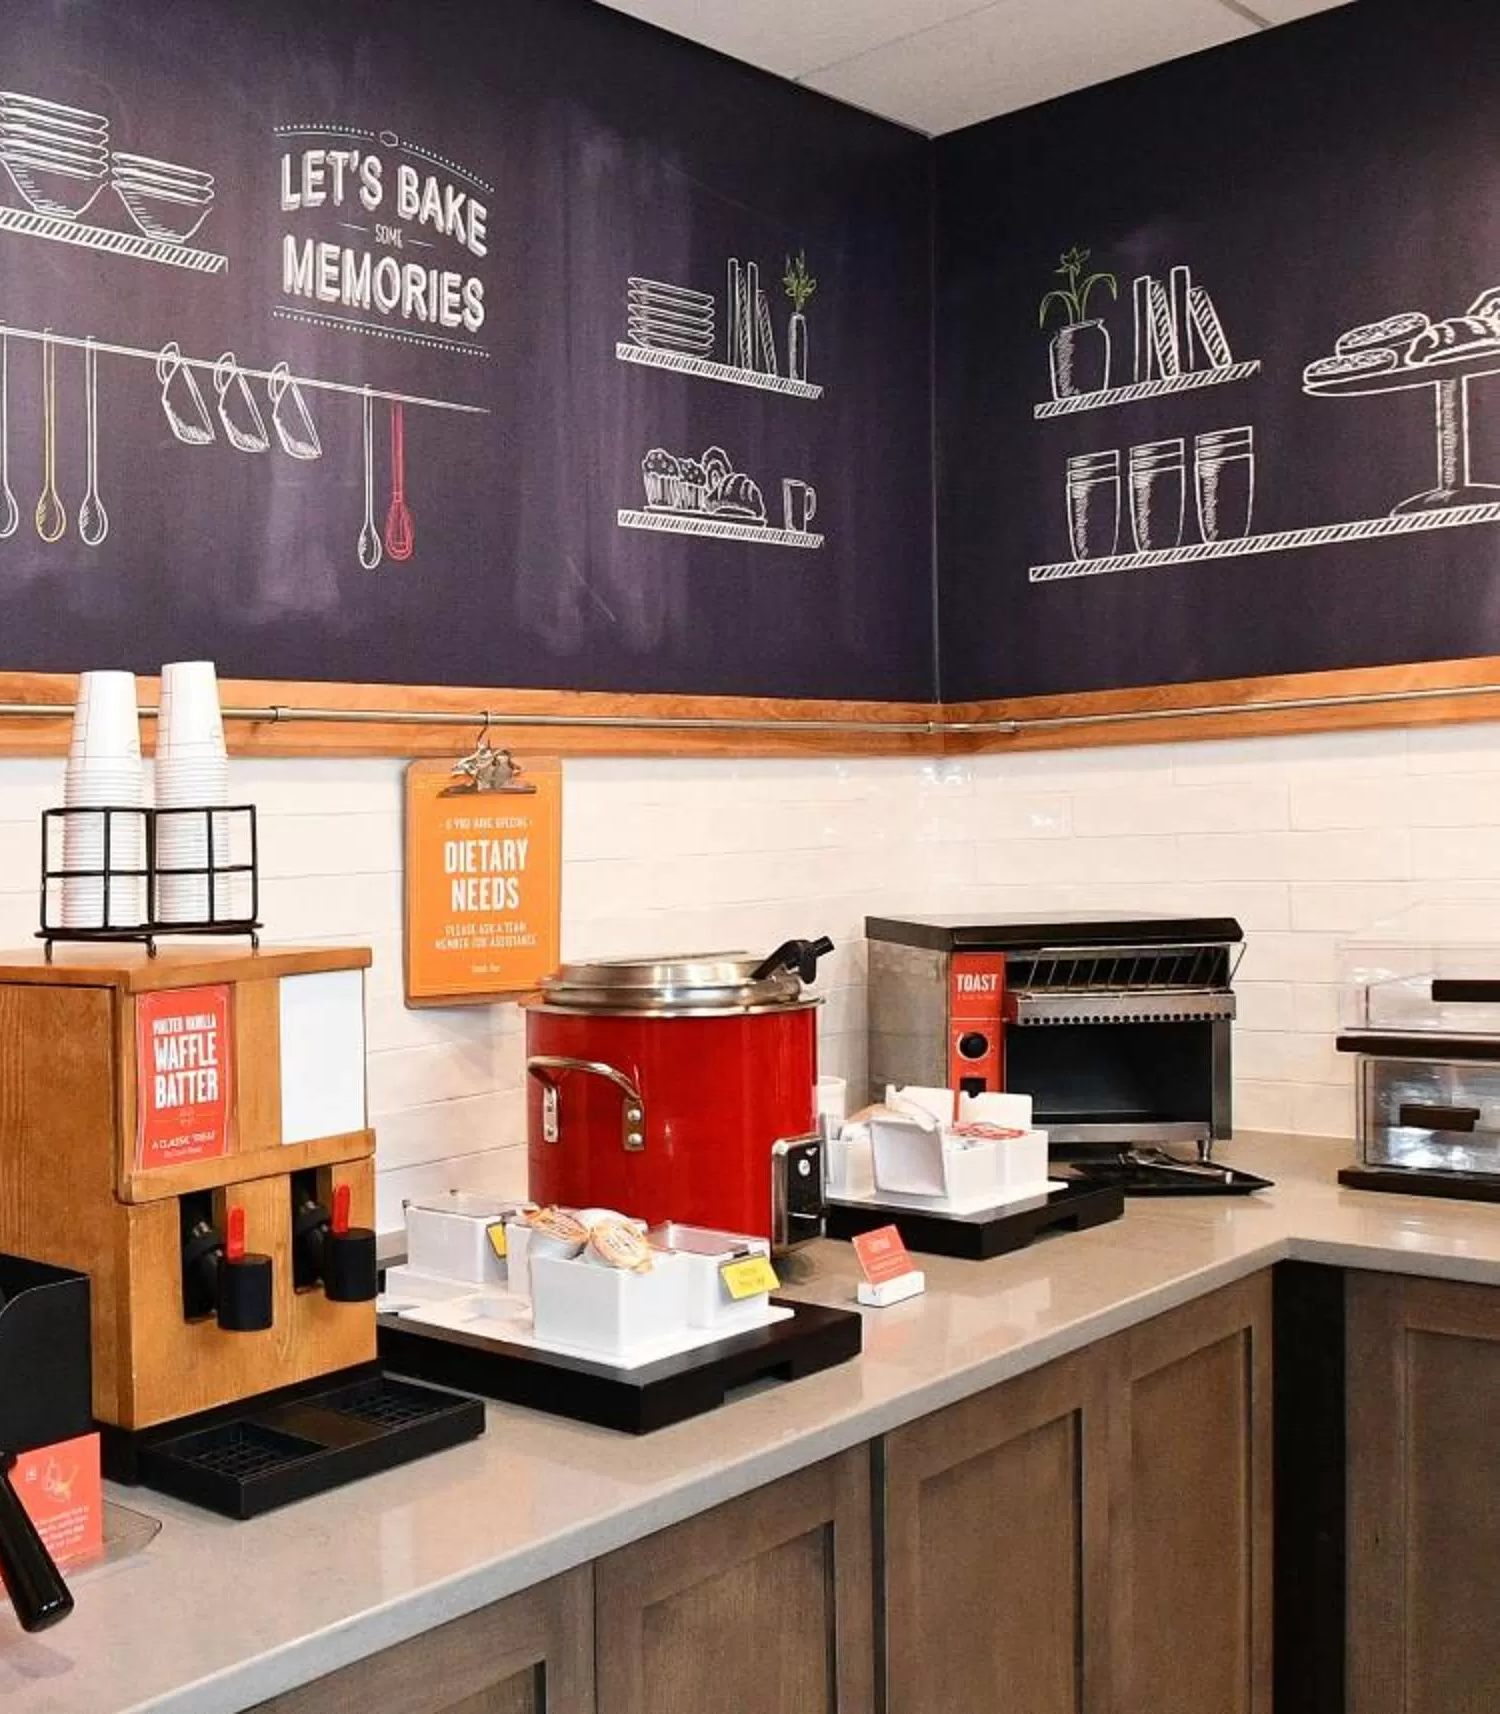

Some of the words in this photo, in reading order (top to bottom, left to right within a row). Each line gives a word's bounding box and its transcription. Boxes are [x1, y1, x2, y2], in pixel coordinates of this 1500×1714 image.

[280, 149, 383, 211] LET'S
[397, 164, 488, 257] BAKE
[375, 223, 403, 249] SOME
[283, 234, 485, 333] MEMORIES
[444, 839, 529, 874] DIETARY
[451, 877, 519, 912] NEEDS
[956, 973, 998, 993] TOAST
[153, 1031, 218, 1072] WAFFLE
[155, 1068, 219, 1109] BATTER
